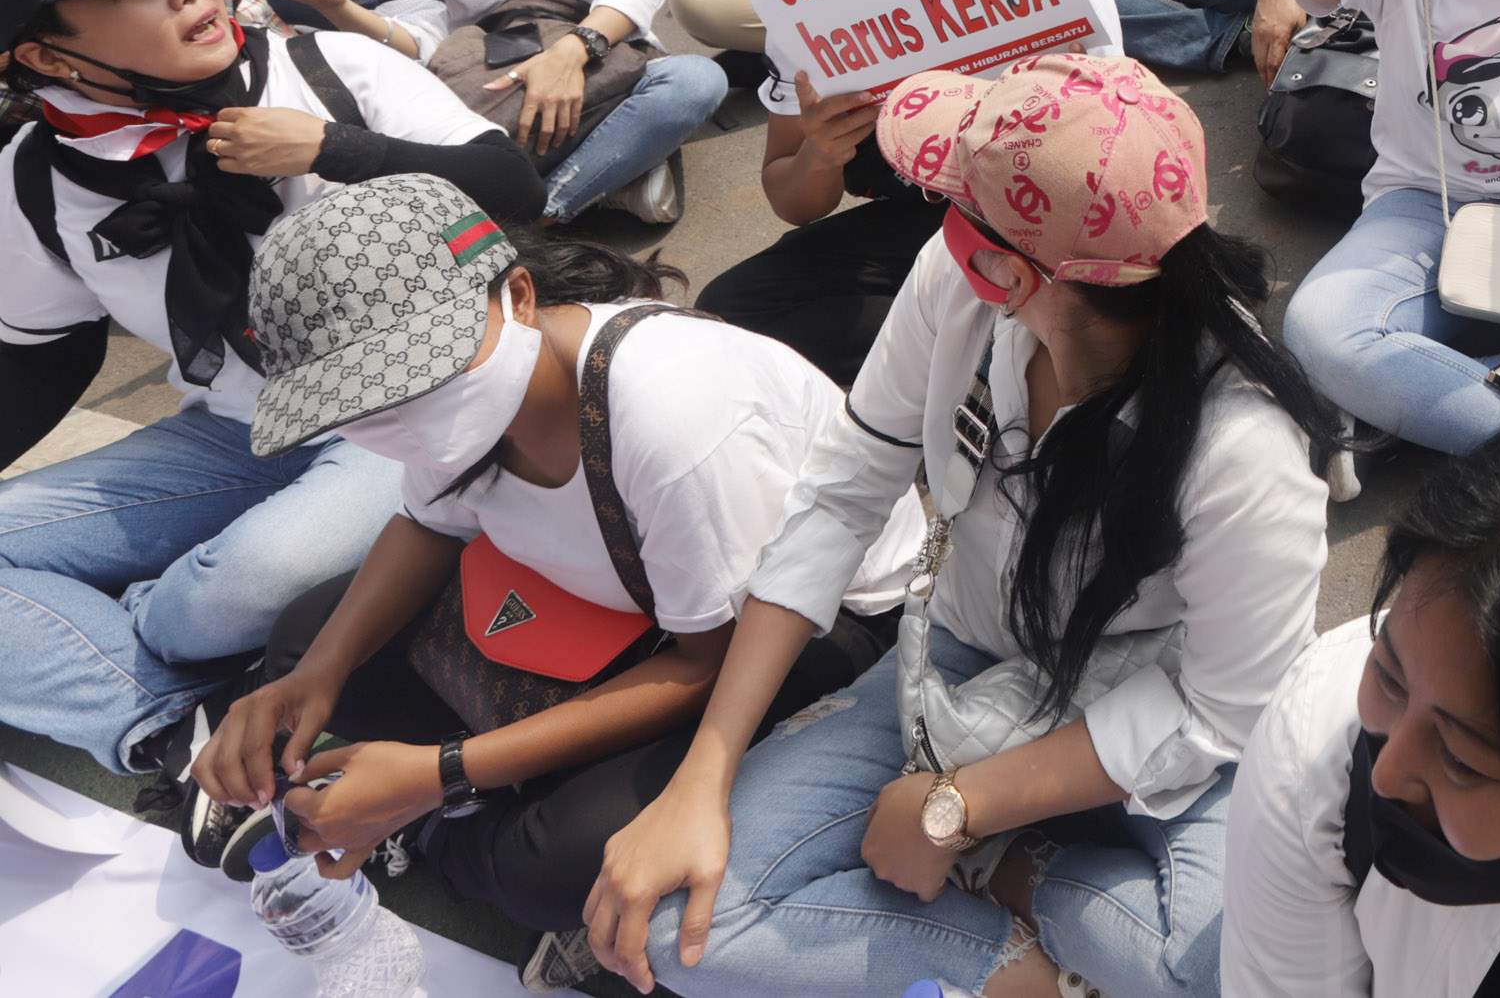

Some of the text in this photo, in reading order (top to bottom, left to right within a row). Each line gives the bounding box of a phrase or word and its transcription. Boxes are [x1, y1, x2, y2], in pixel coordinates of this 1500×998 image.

[796, 6, 925, 79] harus
[972, 43, 1030, 72] HIBURAN
[1030, 24, 1088, 53] BERSATU
[1002, 138, 1042, 151] CHANEL
